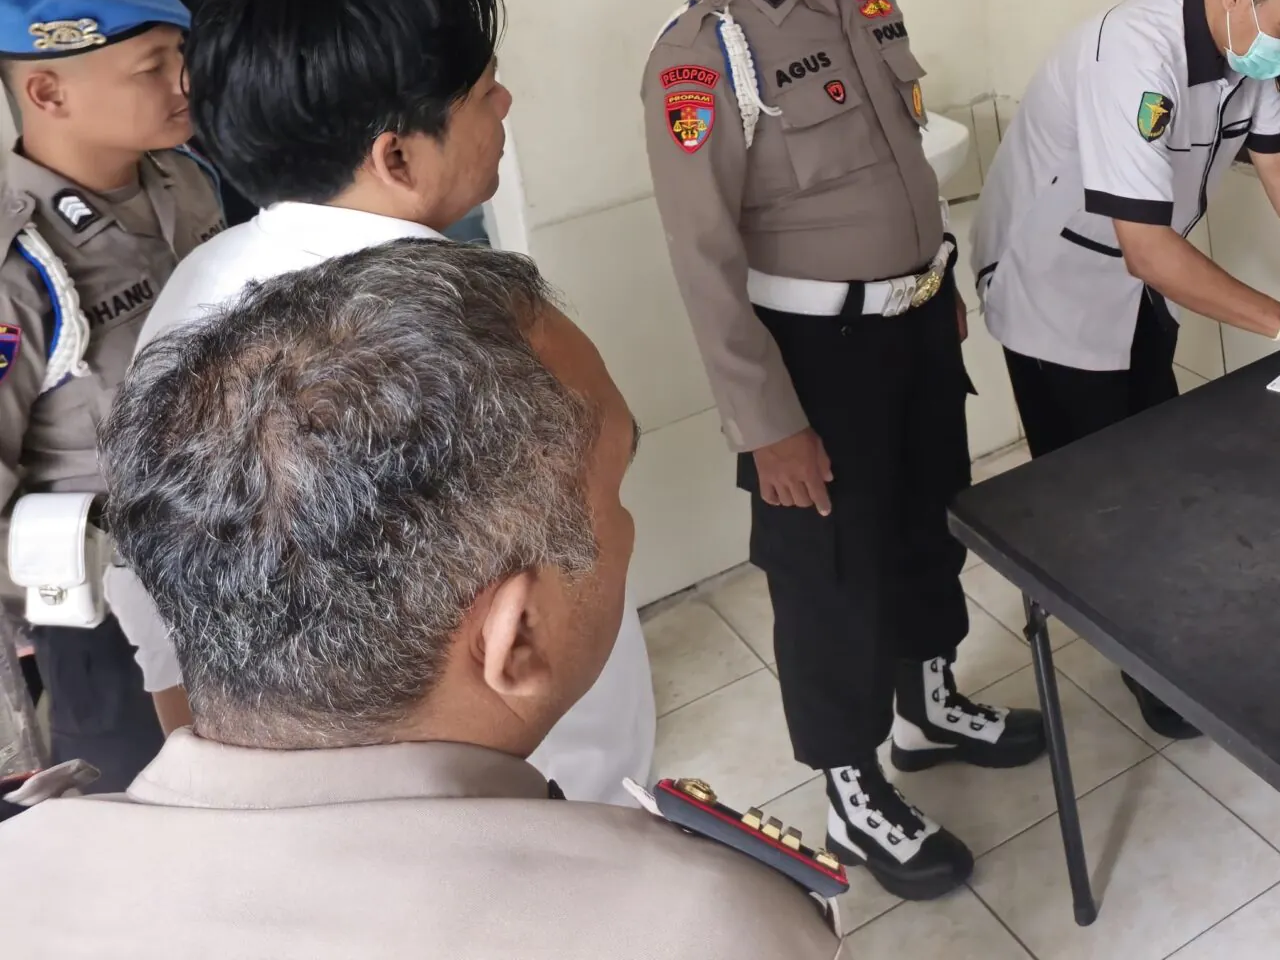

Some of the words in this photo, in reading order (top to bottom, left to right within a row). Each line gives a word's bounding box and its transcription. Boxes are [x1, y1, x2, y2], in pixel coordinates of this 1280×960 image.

[662, 68, 715, 85] PELOPOR
[775, 51, 832, 88] AGUS
[668, 94, 710, 103] PROPAM
